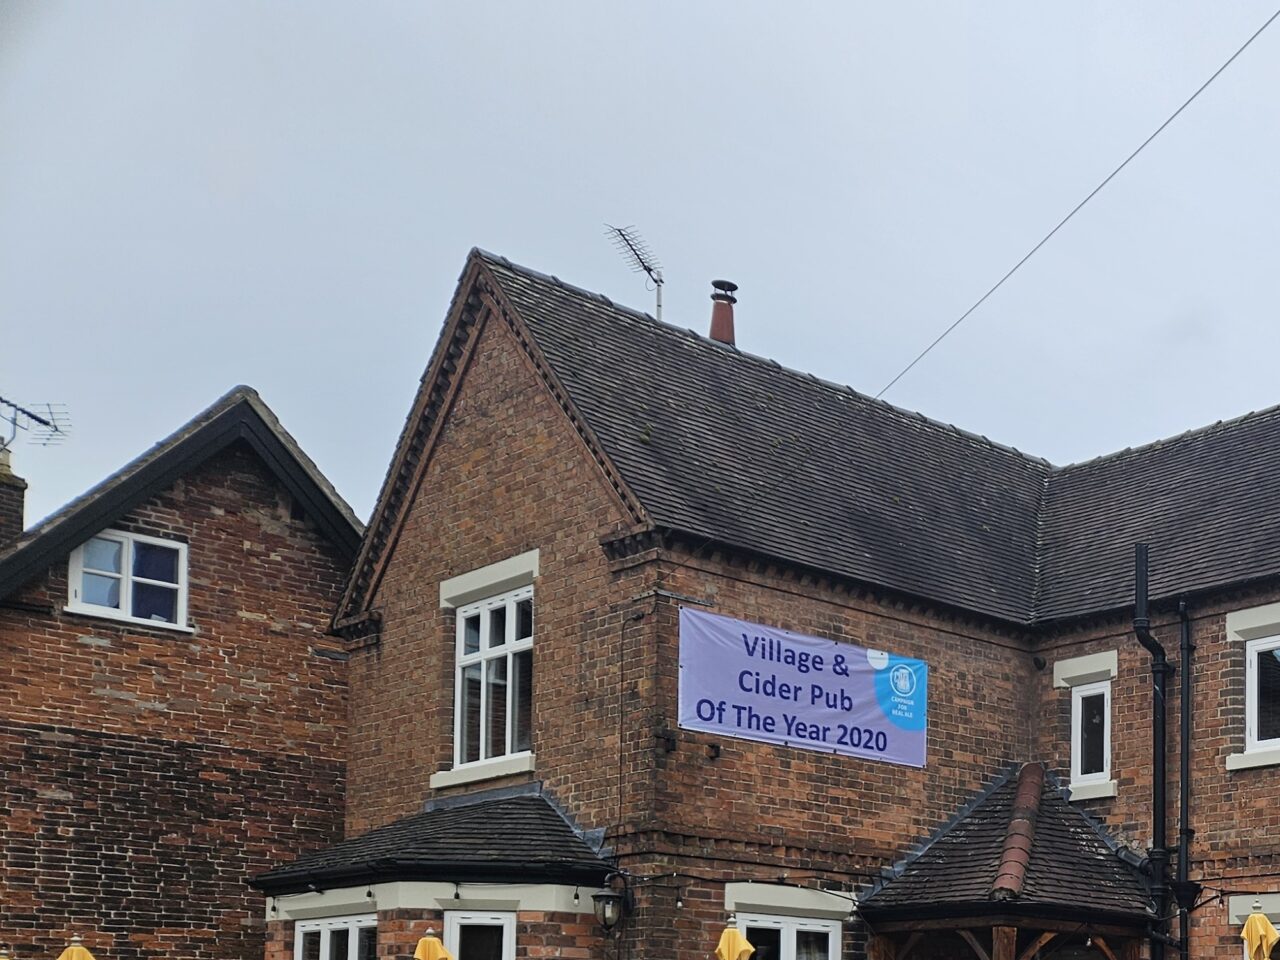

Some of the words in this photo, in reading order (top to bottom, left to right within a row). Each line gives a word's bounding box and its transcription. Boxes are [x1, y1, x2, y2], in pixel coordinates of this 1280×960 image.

[742, 633, 824, 674] Village
[832, 654, 850, 677] &
[738, 670, 803, 702] Cider
[811, 684, 853, 712] Pub
[696, 699, 727, 724] Of
[732, 704, 776, 732] The
[782, 713, 831, 742] Year
[837, 724, 888, 752] 2020
